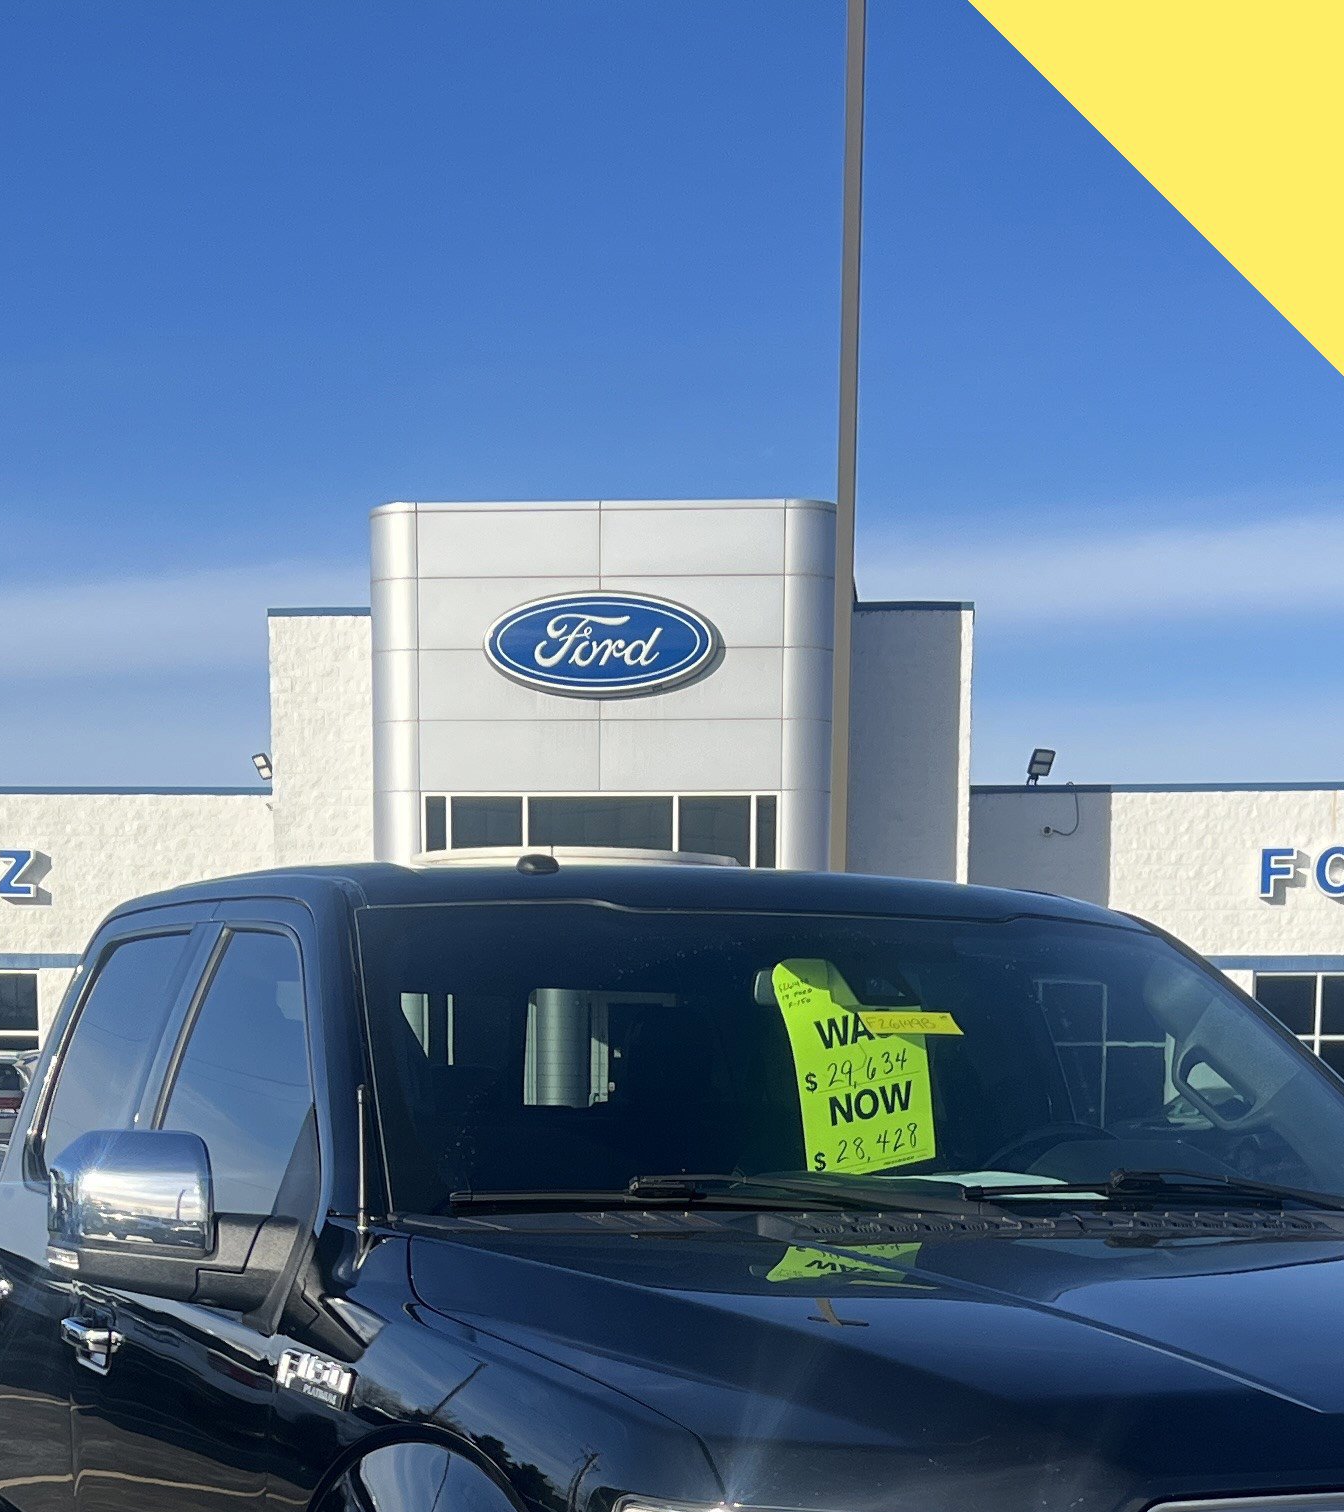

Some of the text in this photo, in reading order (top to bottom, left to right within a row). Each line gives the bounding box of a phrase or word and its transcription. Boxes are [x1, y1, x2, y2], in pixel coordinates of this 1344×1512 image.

[534, 612, 662, 667] Ford
[814, 1010, 894, 1050] WA
[805, 1072, 818, 1094] $
[829, 1079, 912, 1127] NOW
[814, 1151, 827, 1172] $
